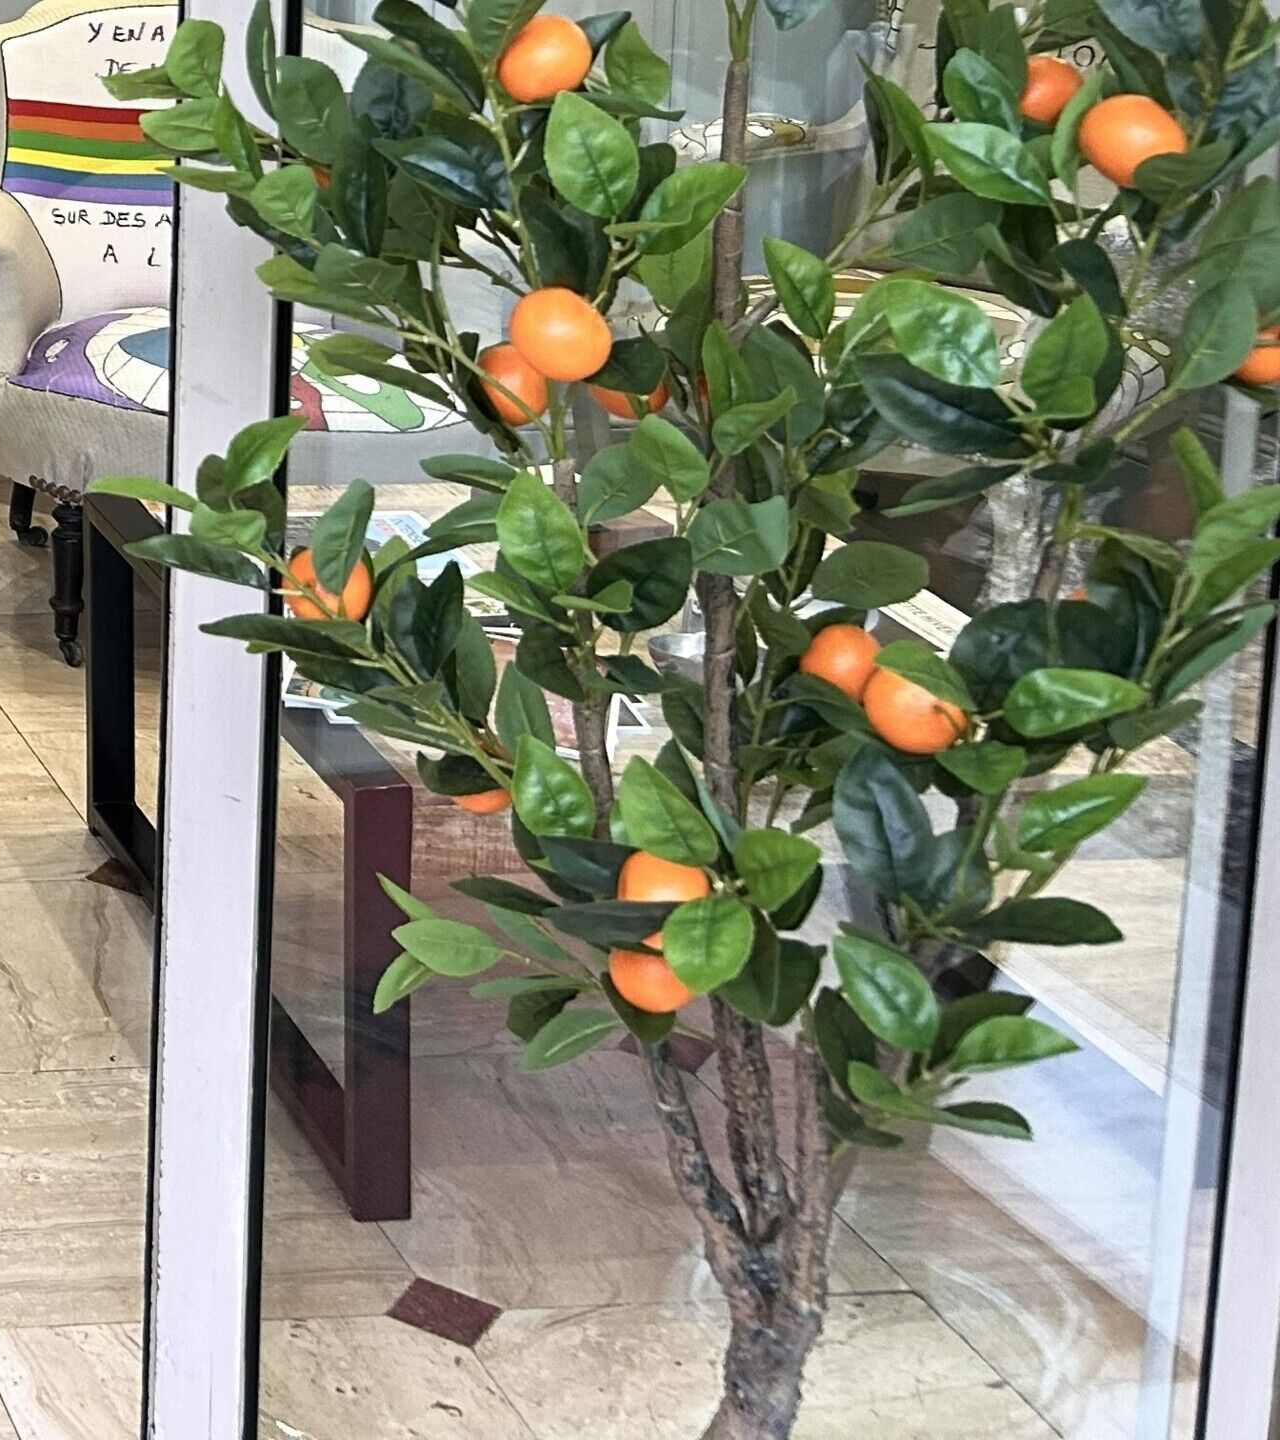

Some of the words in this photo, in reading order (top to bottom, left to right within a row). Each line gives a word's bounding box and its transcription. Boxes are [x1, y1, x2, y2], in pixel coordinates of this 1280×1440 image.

[87, 22, 104, 43] Y
[51, 208, 91, 225] SUR
[99, 210, 146, 227] DES
[102, 243, 119, 264] A
